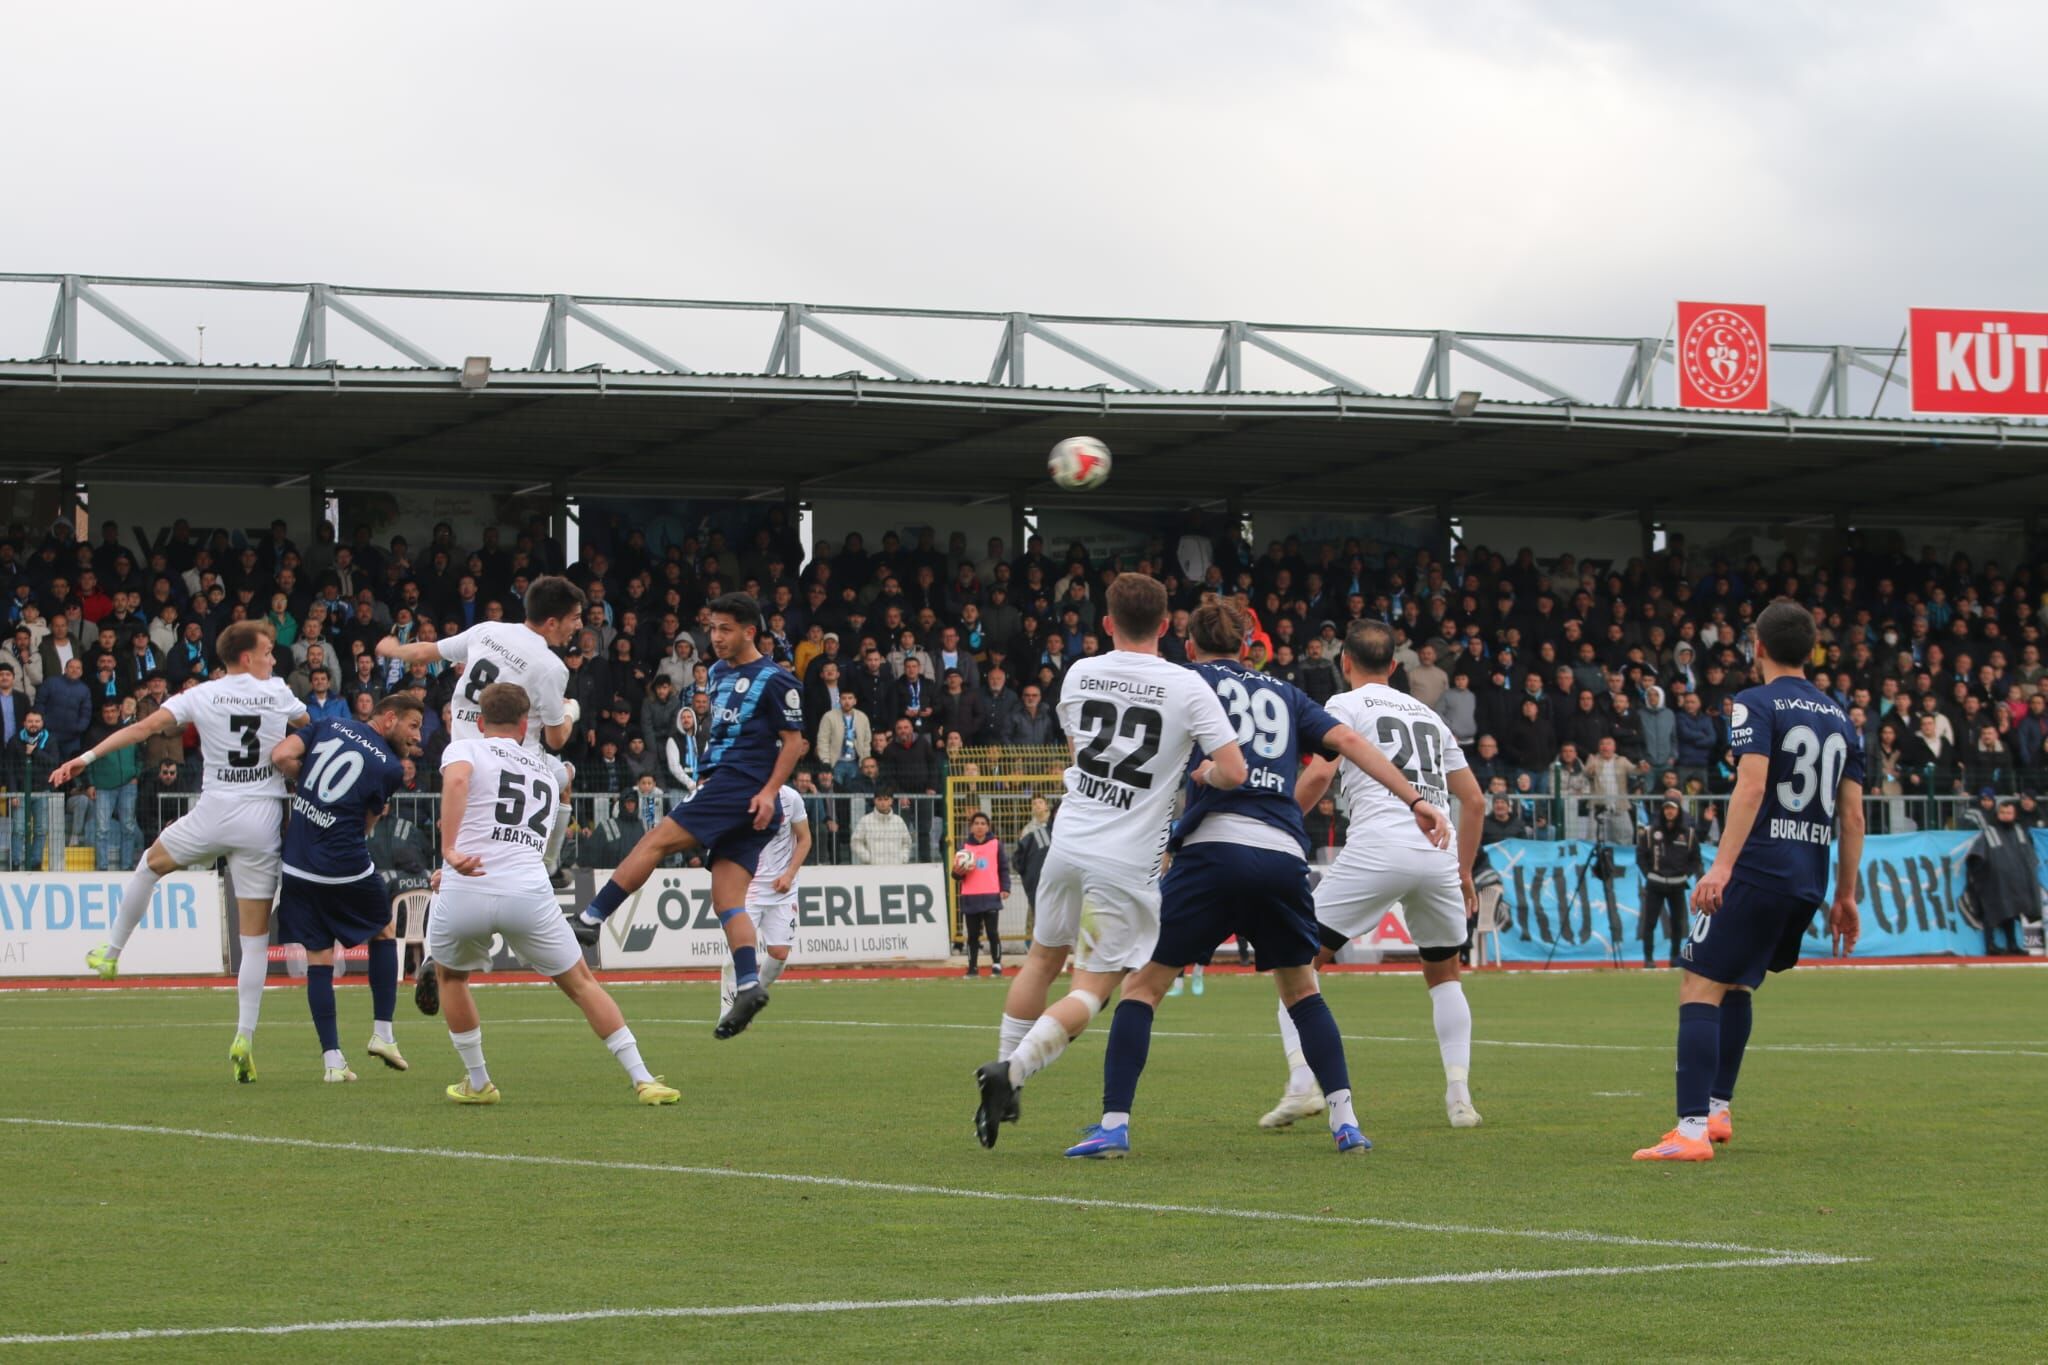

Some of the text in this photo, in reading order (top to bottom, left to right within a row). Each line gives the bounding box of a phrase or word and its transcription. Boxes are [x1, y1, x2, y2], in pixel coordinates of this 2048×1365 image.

[1936, 322, 2048, 393] KÜT
[1080, 679, 1166, 698] DENIPOLLIFE
[228, 714, 261, 768] 3
[1077, 700, 1163, 789] 22
[1216, 677, 1290, 759] 39
[303, 737, 364, 803] 10
[1249, 766, 1285, 793] ÇİFT
[1376, 716, 1445, 791] 20
[1776, 725, 1847, 818] 30
[494, 769, 552, 838] 52
[1076, 773, 1134, 810] DUYAN
[491, 826, 545, 854] K.BAYRAK
[0, 942, 28, 963] AT
[691, 933, 909, 956] HAFRİY SONDAJ LOJİSTİK
[1689, 909, 1711, 943] 0
